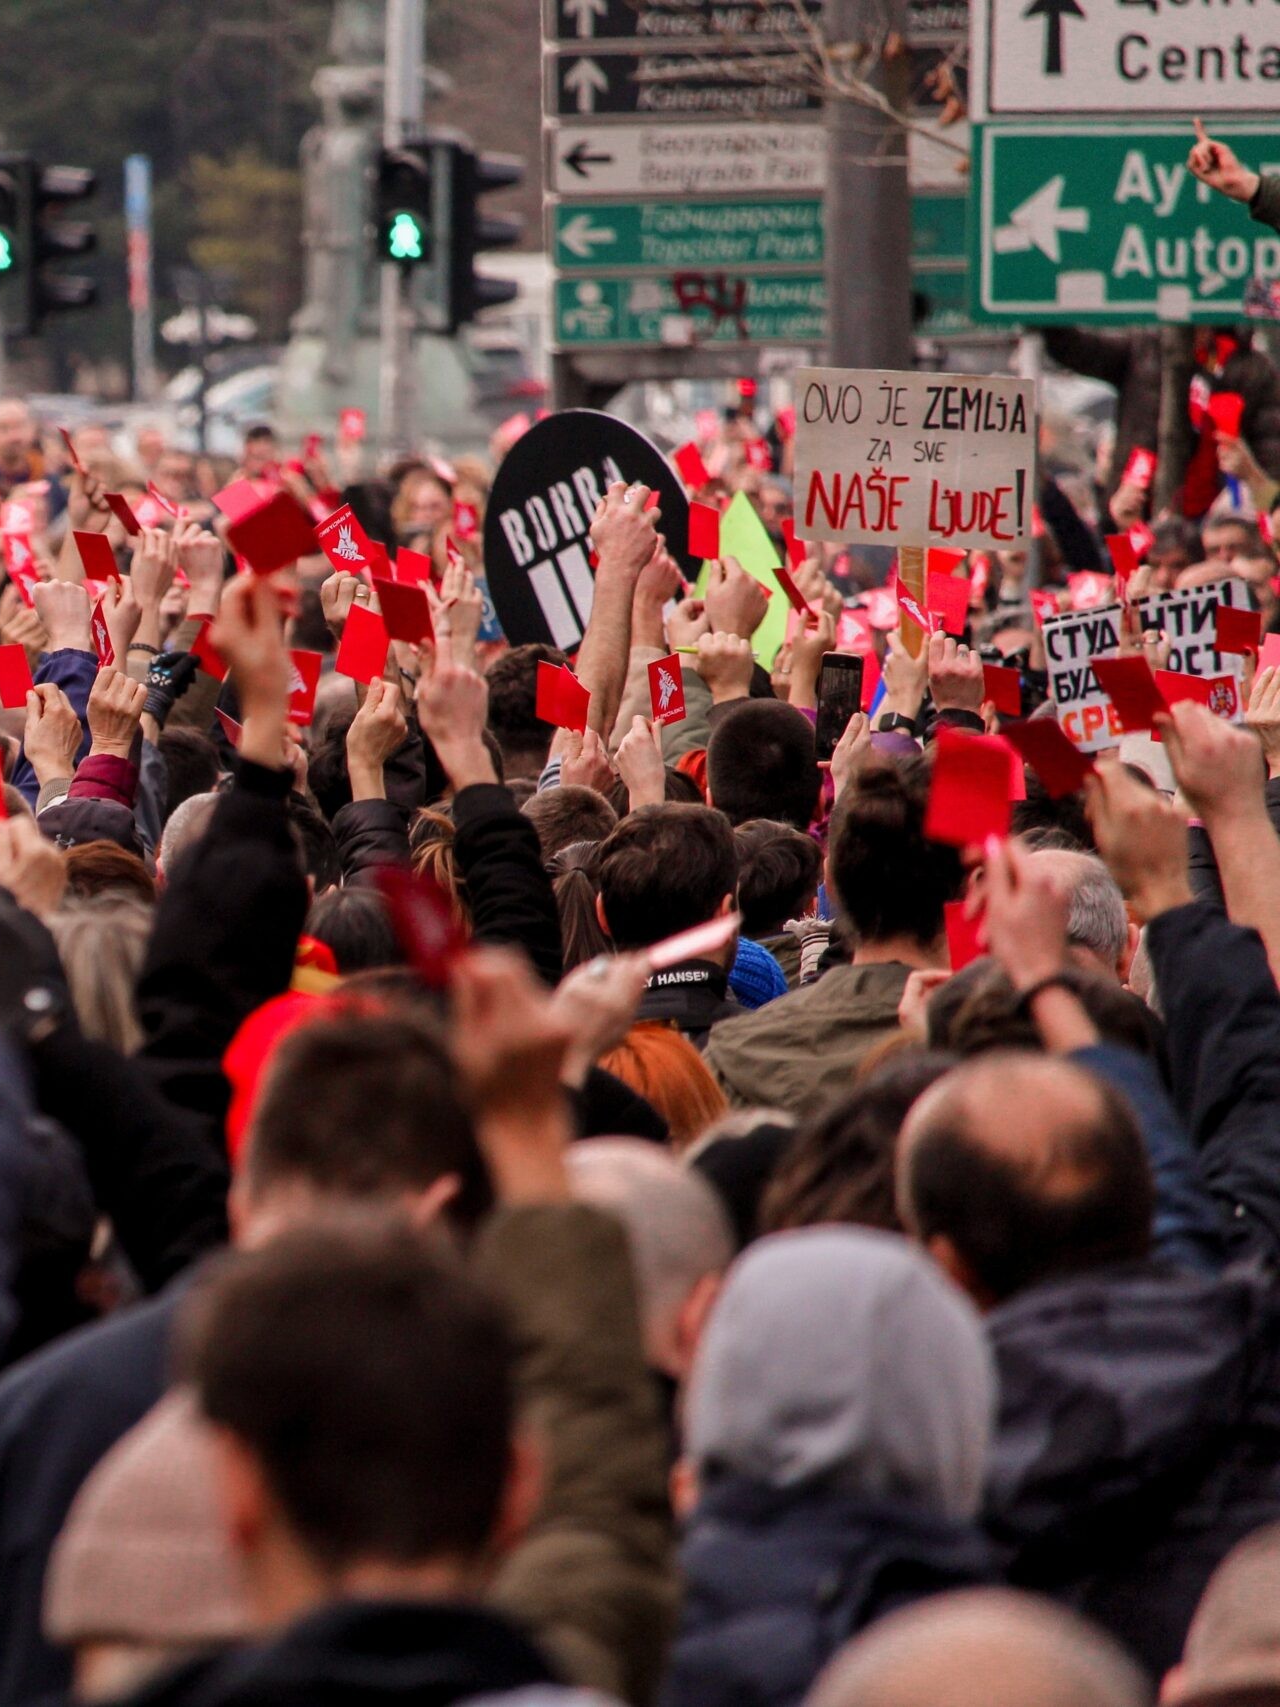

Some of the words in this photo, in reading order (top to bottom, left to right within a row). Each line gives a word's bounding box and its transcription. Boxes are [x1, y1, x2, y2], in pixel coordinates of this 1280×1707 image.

[1113, 224, 1280, 281] Autop
[803, 382, 862, 424] OVO
[866, 438, 892, 462] ZA
[913, 440, 948, 463] SVE
[804, 466, 911, 532] NAŠE
[657, 971, 710, 986] HANSEN
